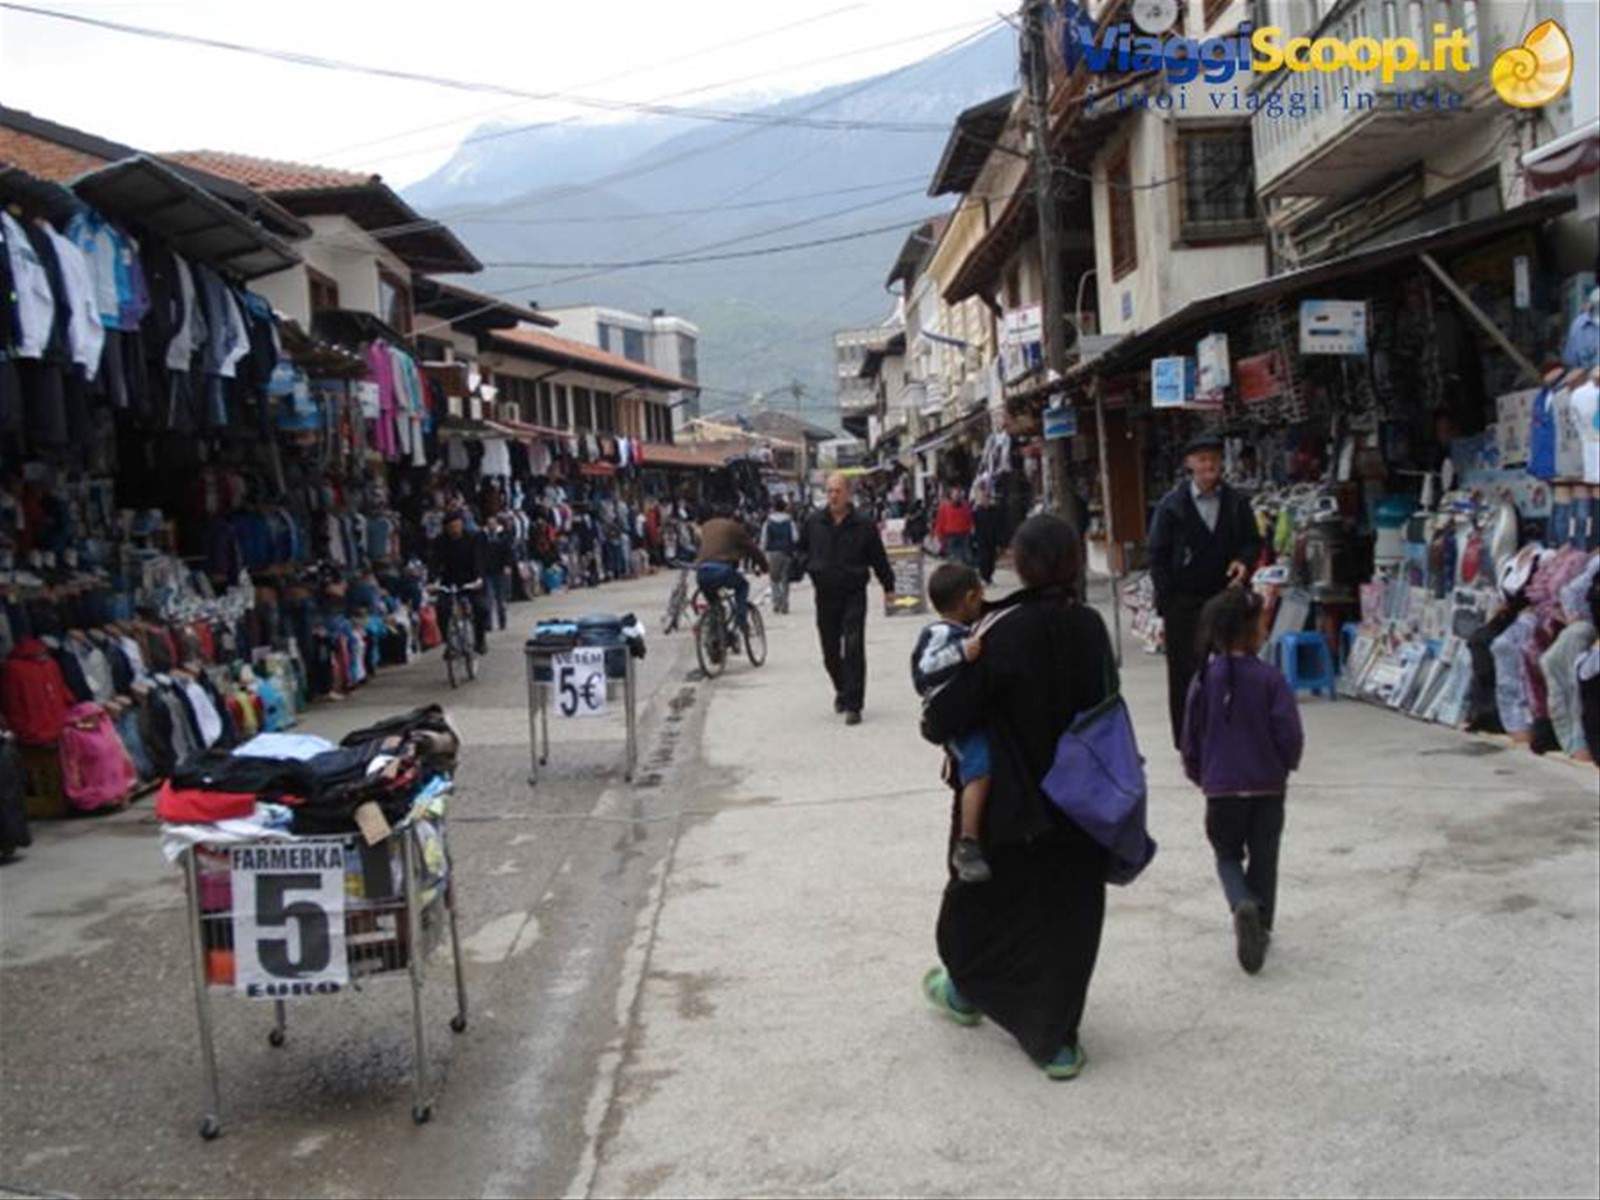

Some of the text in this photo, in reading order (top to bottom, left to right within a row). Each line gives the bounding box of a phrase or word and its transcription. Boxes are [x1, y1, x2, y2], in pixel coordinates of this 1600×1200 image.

[560, 666, 602, 717] 5€
[232, 847, 342, 871] FARMERKA
[256, 873, 331, 979] 5
